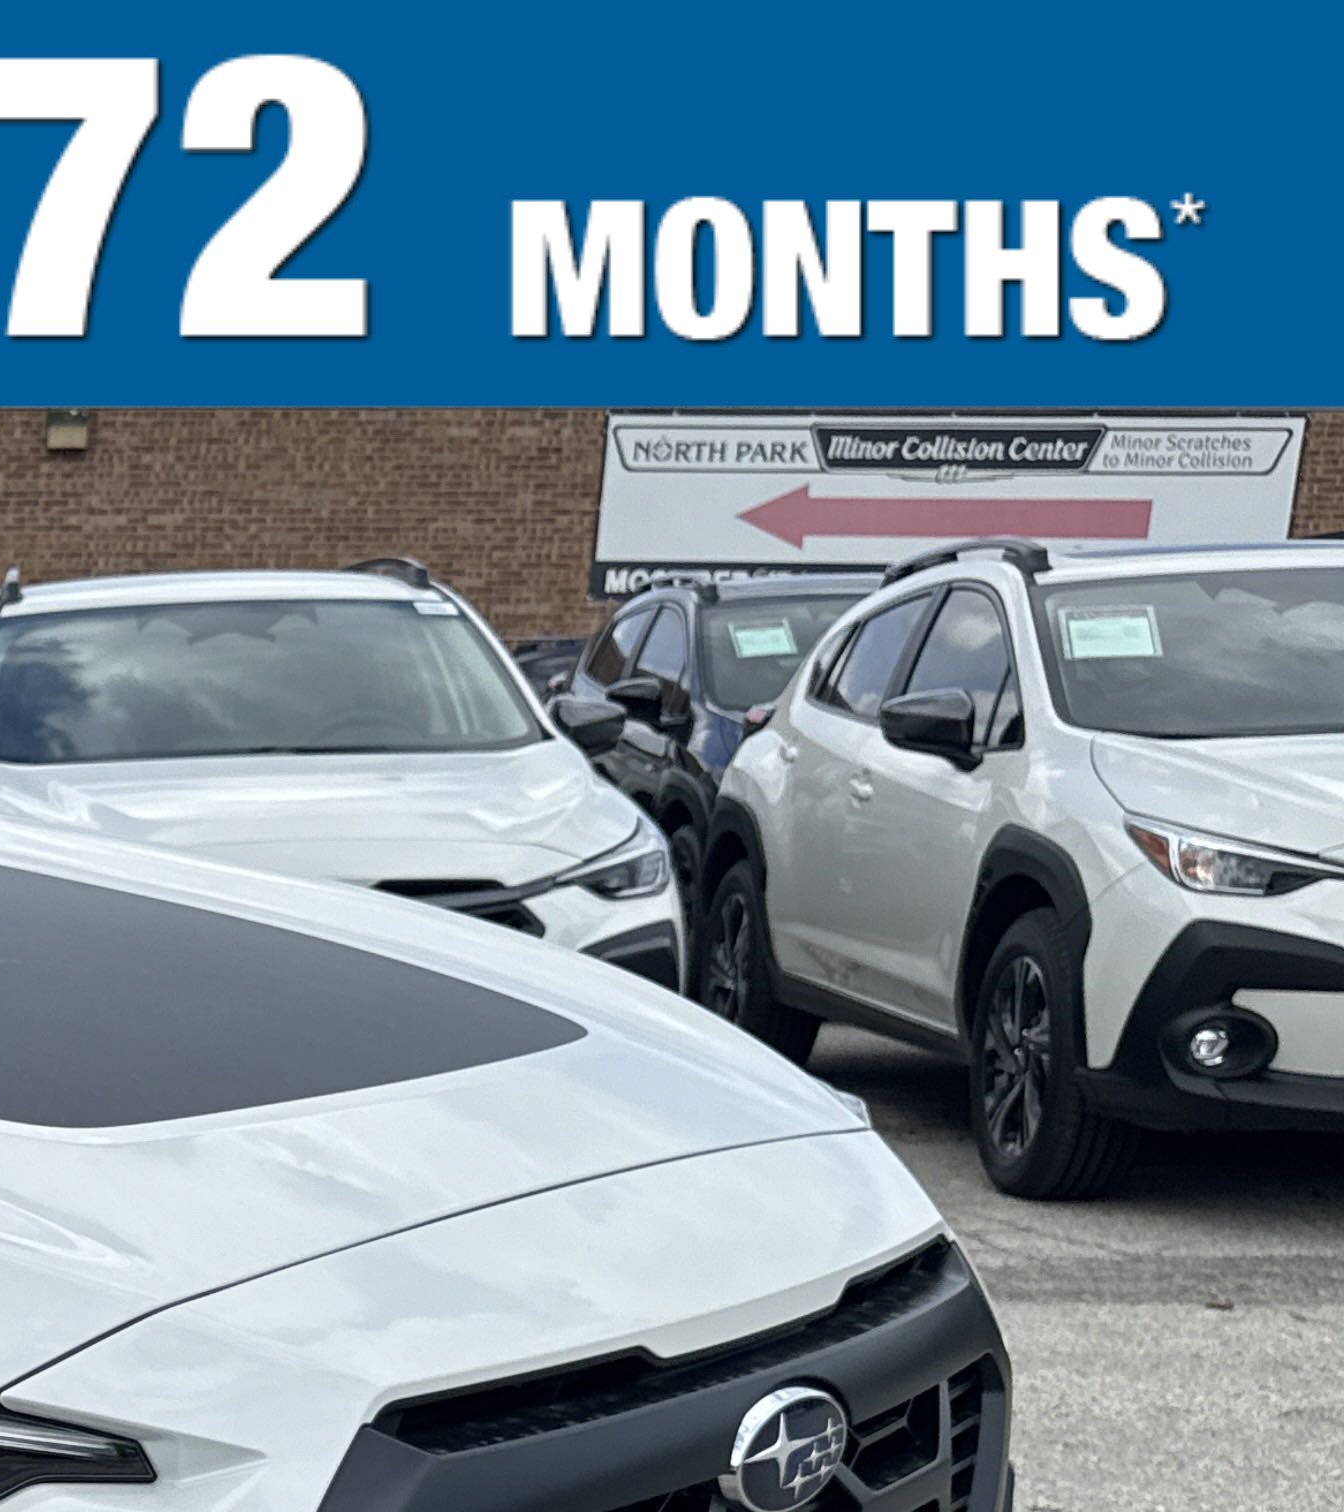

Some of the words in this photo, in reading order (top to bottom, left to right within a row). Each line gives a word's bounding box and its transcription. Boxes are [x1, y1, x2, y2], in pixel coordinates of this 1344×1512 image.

[632, 438, 727, 463] NORTH
[735, 440, 809, 463] PARK
[827, 434, 900, 461] Minor
[901, 435, 1004, 461] Collision
[1008, 436, 1088, 461] Center
[1110, 433, 1161, 450] Minor
[1166, 433, 1252, 451] Scratches
[1102, 453, 1120, 468] to
[1124, 453, 1175, 468] Minor
[1177, 452, 1253, 469] Collision
